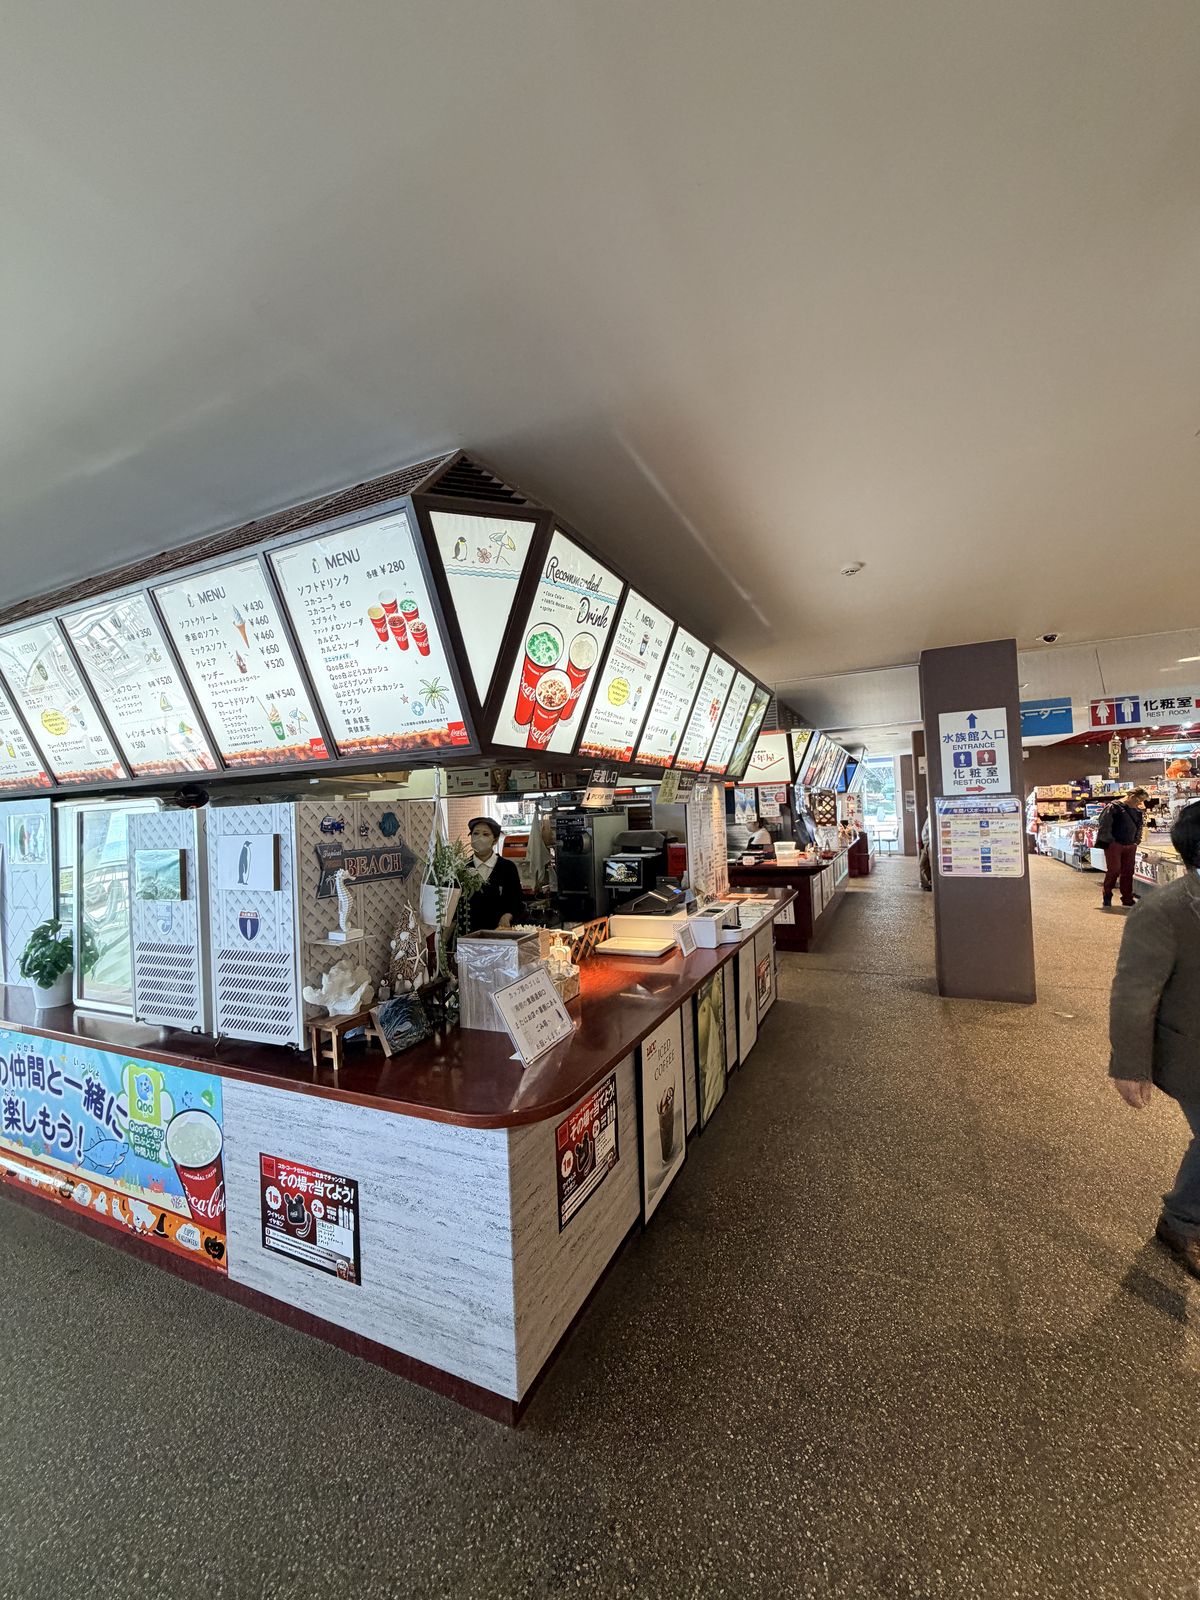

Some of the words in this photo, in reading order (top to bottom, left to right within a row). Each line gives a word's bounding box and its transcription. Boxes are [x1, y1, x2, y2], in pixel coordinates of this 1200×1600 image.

[325, 548, 361, 570] MENU
[379, 560, 406, 576] ¥280
[297, 574, 350, 596] ソフトドリンク
[196, 586, 227, 605] MENU
[178, 613, 218, 629] ソフトクリーム
[311, 614, 338, 626] スプライト
[577, 597, 610, 629] Drink
[184, 627, 220, 642] 季節のソフト
[248, 614, 270, 628] ¥460
[330, 618, 365, 632] メロンソーダ
[641, 613, 656, 630] MENU
[190, 640, 228, 656] ミックスソフト
[253, 629, 275, 642] ¥460
[318, 635, 341, 645] カルピス
[320, 639, 360, 654] カルピスソーダ
[195, 657, 217, 669] クレミア
[259, 643, 280, 656] ¥650
[263, 657, 285, 670] ¥520
[326, 660, 359, 672] Qoo白ぶどう
[332, 677, 374, 690] 山ぶどうブレンド
[211, 695, 255, 709] フロートドリンク
[275, 687, 296, 700] ¥540
[338, 699, 360, 707] アップル
[1143, 696, 1193, 712] 化粧室
[341, 707, 362, 716] オレンジ
[1168, 708, 1191, 717] ROOM
[942, 728, 1006, 744] 水族館入口
[130, 740, 146, 750] ¥500
[952, 741, 996, 751] ENTRANCE
[591, 769, 618, 784] 受渡し口
[953, 766, 999, 780] 化粧室
[953, 778, 973, 786] REST
[975, 777, 1000, 785] ROOM
[344, 852, 403, 877] BEACH
[657, 1038, 671, 1061] ICED
[73, 1057, 100, 1077] いっしょ
[654, 1049, 675, 1081] COFFEE
[136, 1098, 154, 1114] Qoo
[129, 1120, 165, 1141] Qooすっきり
[133, 1133, 161, 1151] 白ぶどうが
[266, 1210, 286, 1222] ワイヤレス
[268, 1218, 285, 1227] イヤホン
